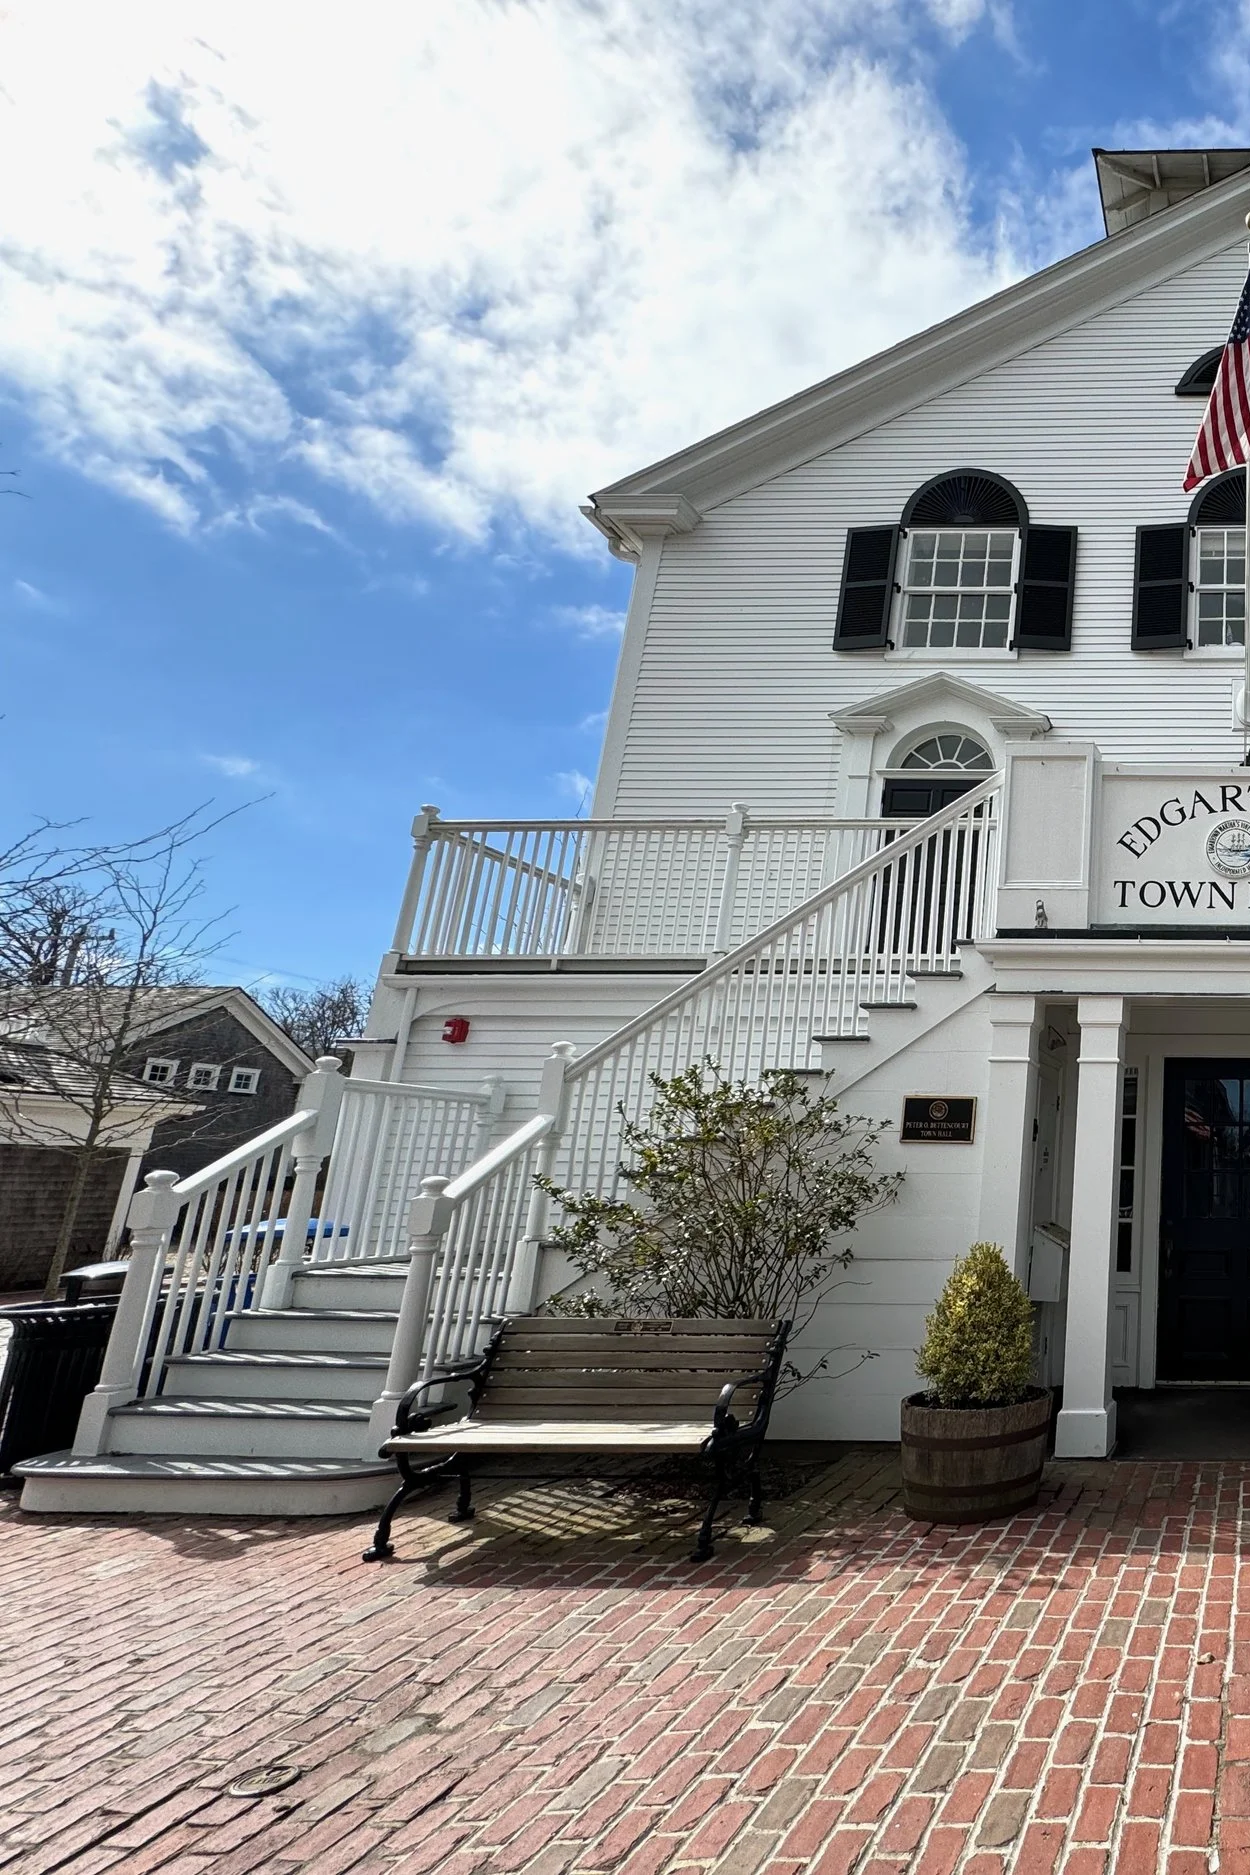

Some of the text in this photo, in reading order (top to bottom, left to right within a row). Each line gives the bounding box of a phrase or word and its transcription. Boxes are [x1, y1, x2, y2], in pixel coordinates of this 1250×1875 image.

[1113, 880, 1238, 911] TOWN
[905, 1121, 924, 1129] PETER
[937, 1130, 953, 1138] HALL
